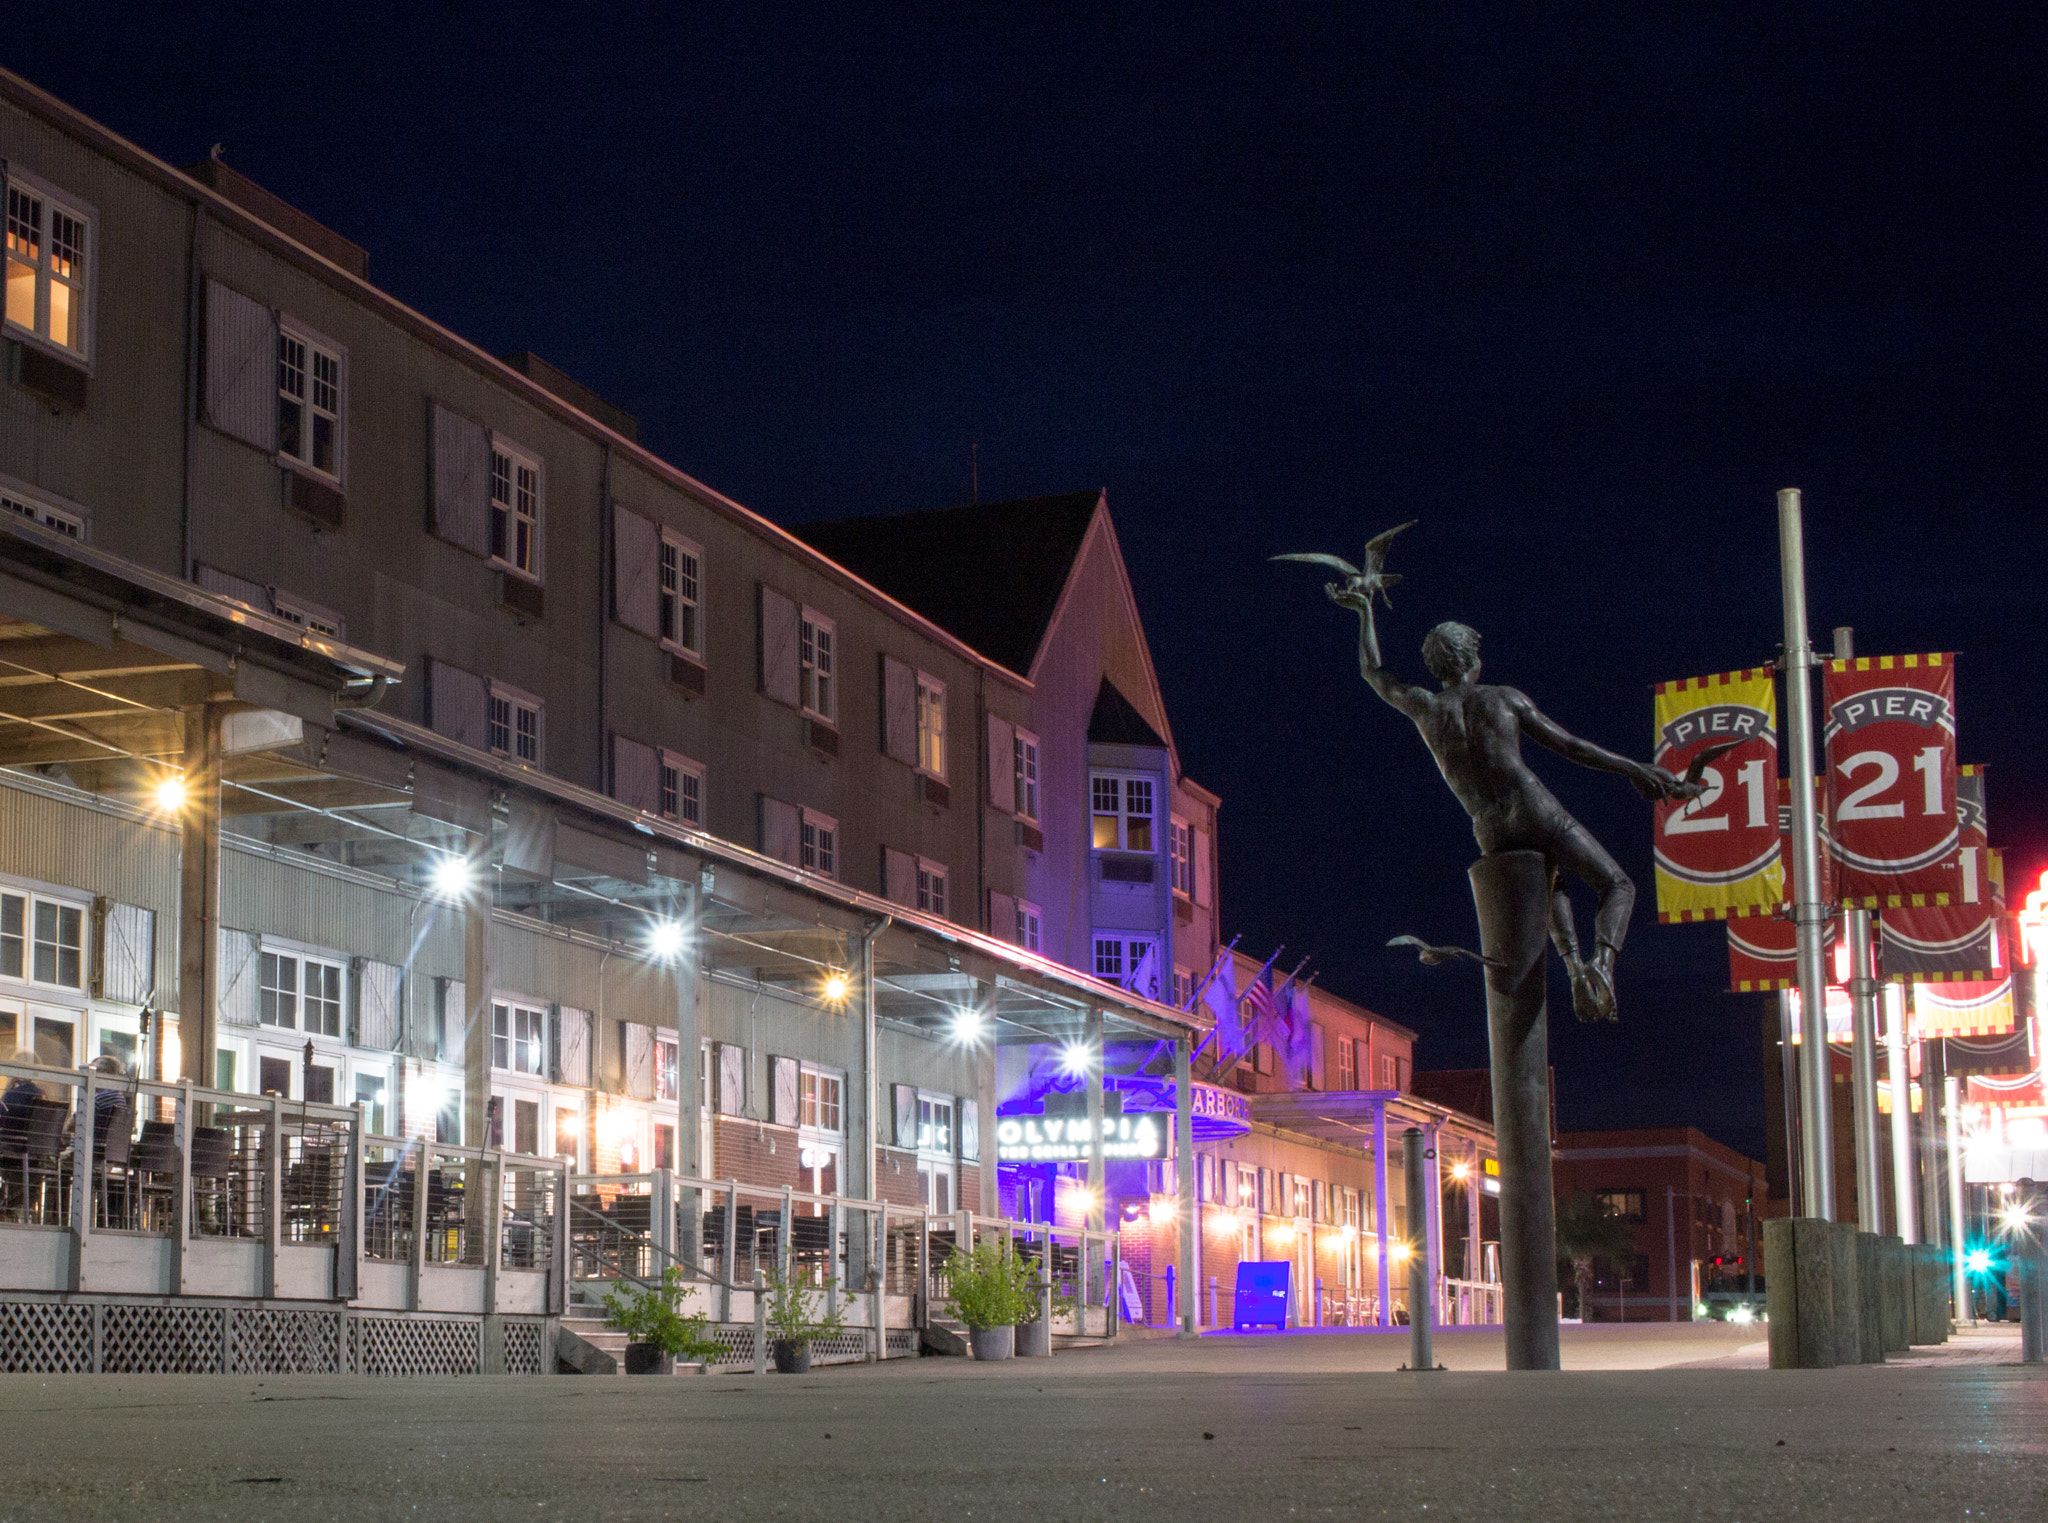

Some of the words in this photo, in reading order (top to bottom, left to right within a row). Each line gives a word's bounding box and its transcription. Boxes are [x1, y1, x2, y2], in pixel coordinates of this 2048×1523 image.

[1674, 711, 1755, 743] PIER
[1845, 697, 1933, 725] PIER
[1664, 759, 1769, 836] 21
[1836, 746, 1947, 823] 21
[1958, 846, 1981, 905] 1
[998, 1117, 1158, 1144] OLYMPIA
